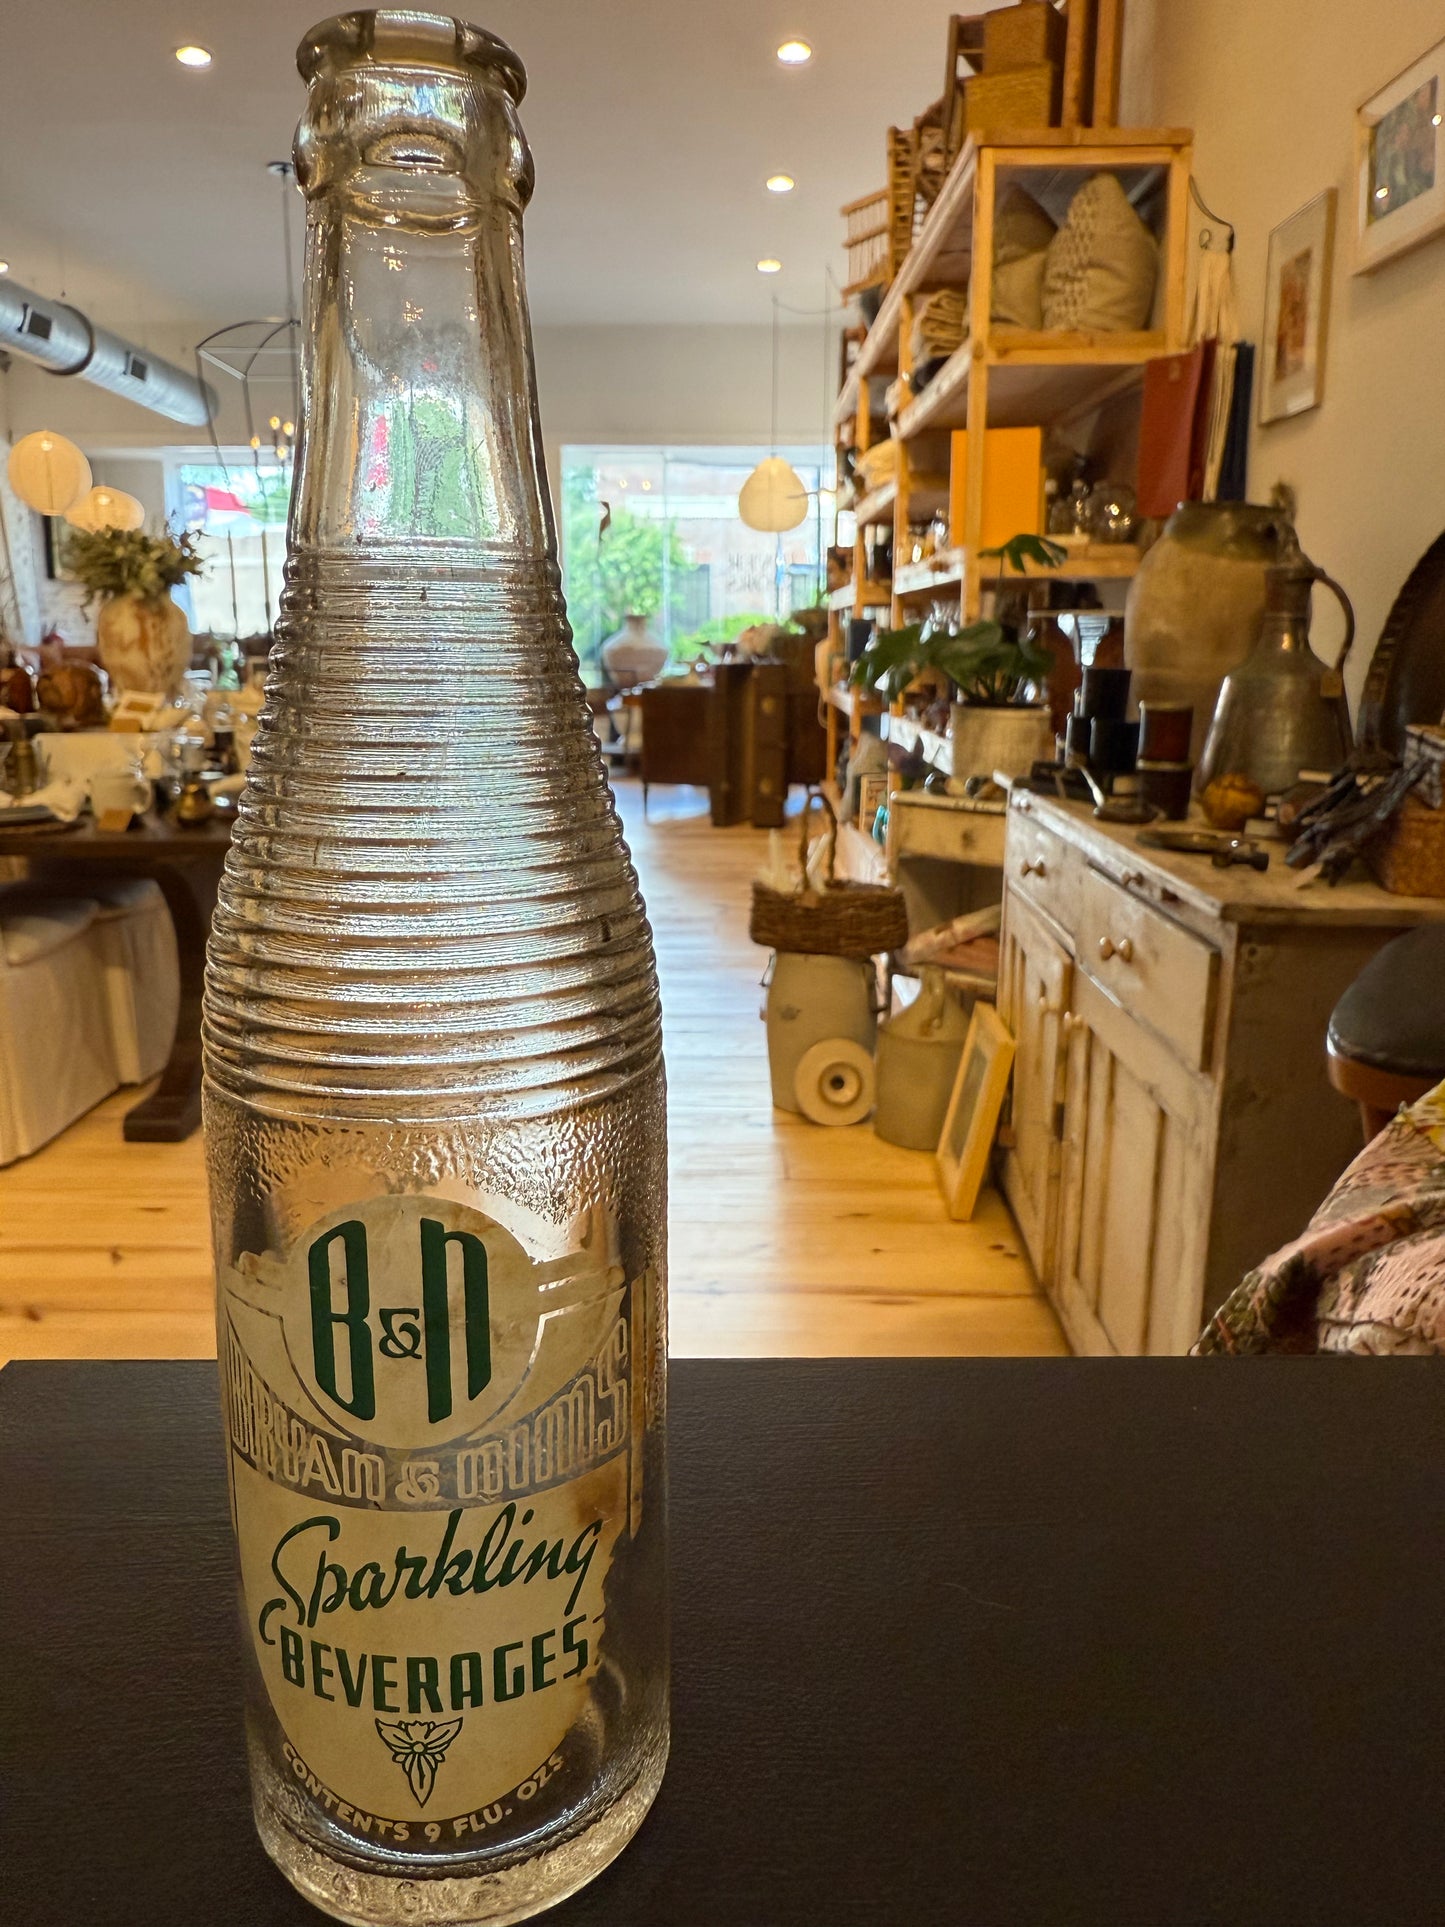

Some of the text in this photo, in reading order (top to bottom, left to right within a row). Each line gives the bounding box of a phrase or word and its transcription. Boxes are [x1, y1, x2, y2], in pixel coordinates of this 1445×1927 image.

[394, 1460, 443, 1503] &
[258, 1502, 604, 1646] Sparkling
[279, 1613, 588, 1714] BEVERAGES
[281, 1741, 410, 1842] CONTENTS
[424, 1822, 442, 1843] 9
[453, 1803, 513, 1839] FLU.
